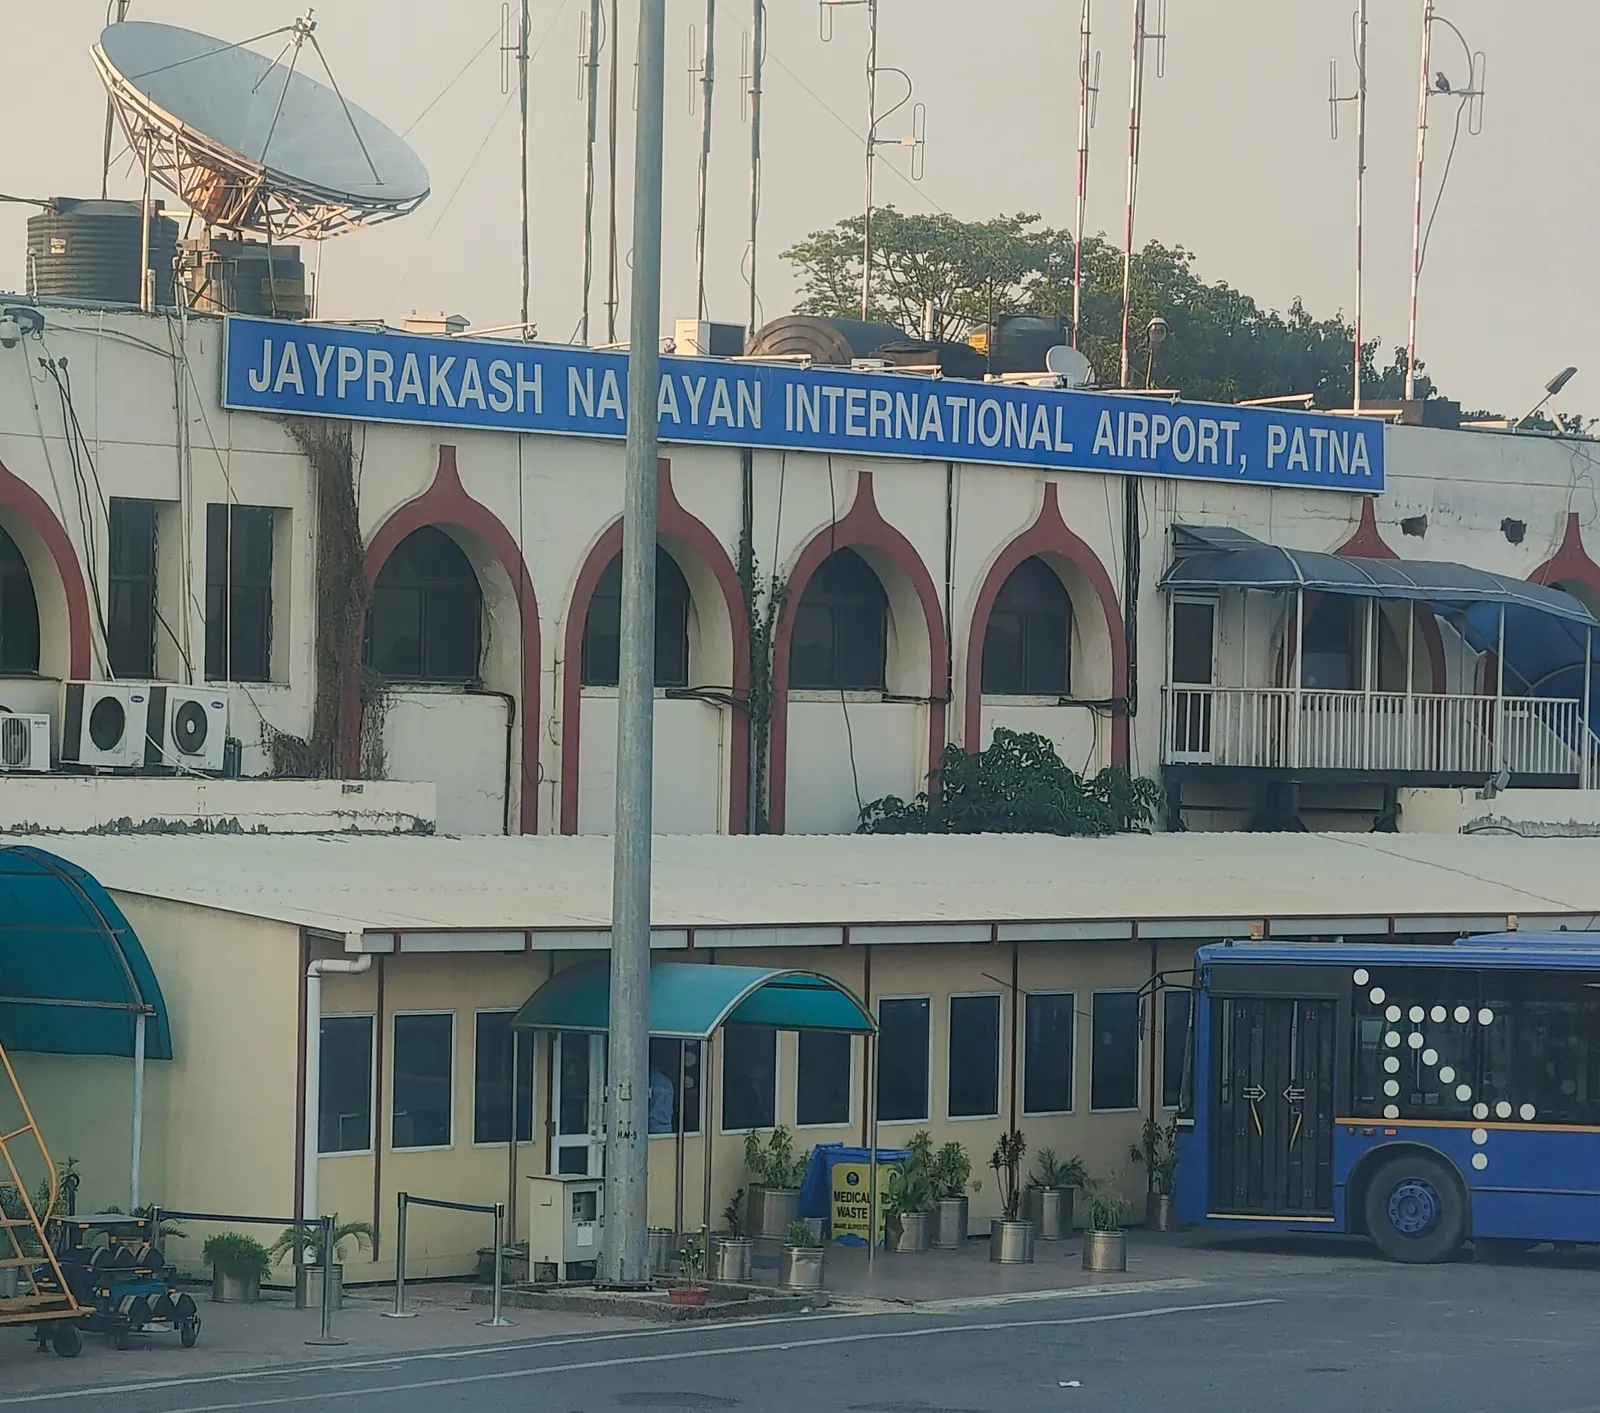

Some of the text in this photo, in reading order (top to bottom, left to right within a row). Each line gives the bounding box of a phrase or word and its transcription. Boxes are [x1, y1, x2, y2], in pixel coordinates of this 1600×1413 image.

[248, 339, 1371, 476] JAYPRAKASH NAAYAN INTERNATIONAL AIRPORT, PATNA
[833, 1190, 871, 1204] MEDICAL
[837, 1206, 868, 1219] WASTE
